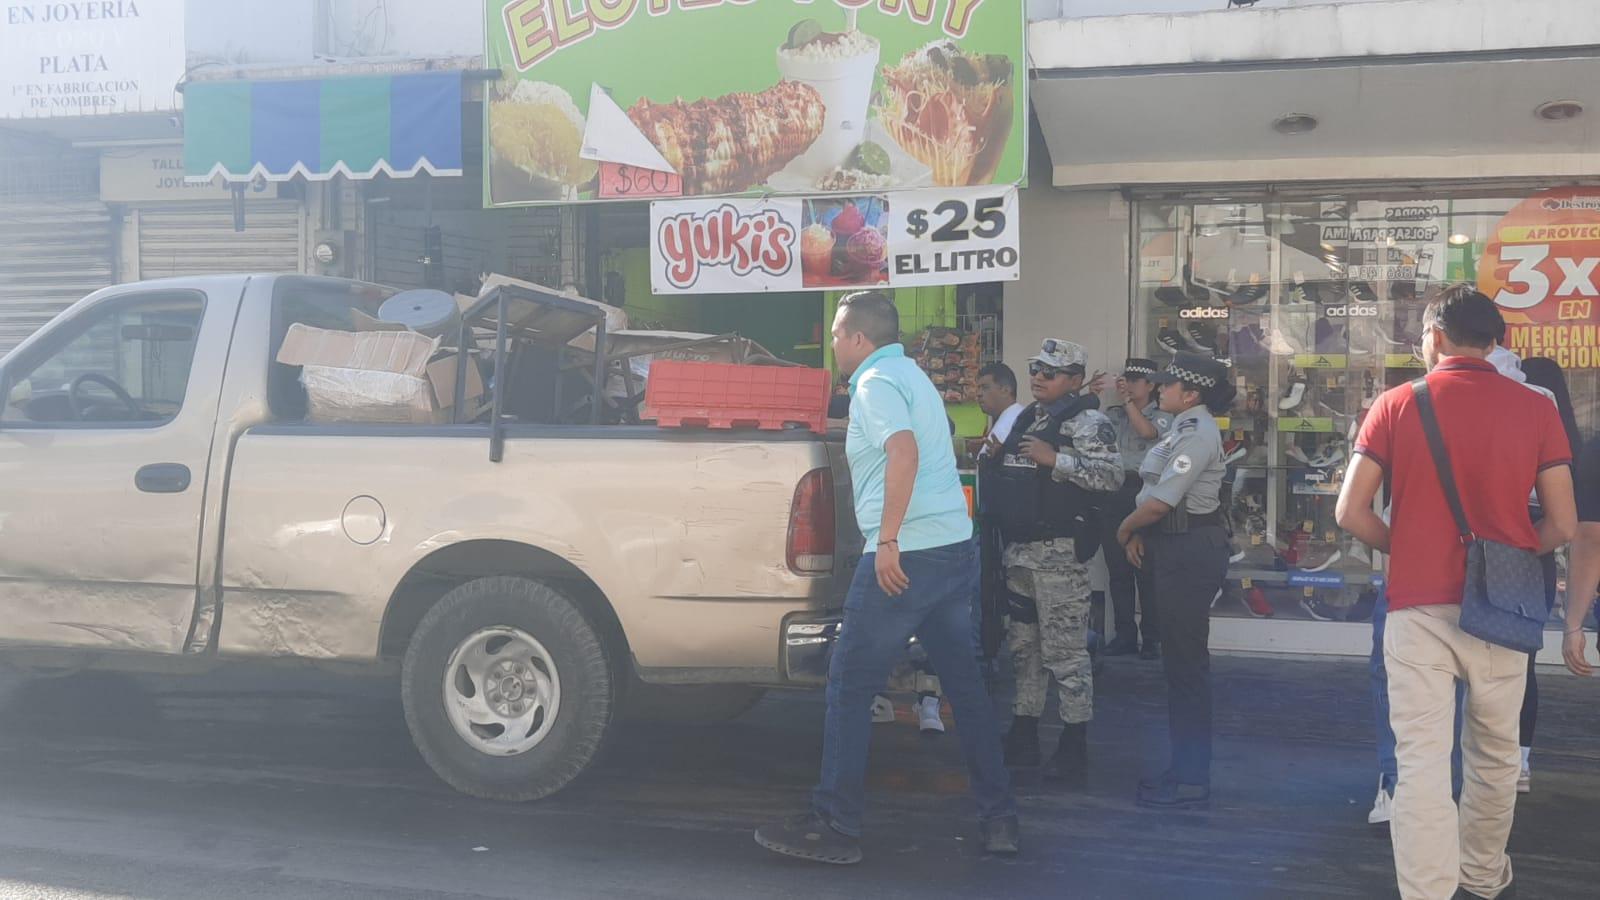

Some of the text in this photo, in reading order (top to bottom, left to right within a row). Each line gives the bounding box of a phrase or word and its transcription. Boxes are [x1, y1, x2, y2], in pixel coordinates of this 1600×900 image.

[8, 6, 35, 25] EN
[40, 54, 109, 74] PLATA
[26, 83, 43, 96] EN
[30, 95, 117, 109] DE NOMBRES
[152, 159, 184, 170] TALL
[905, 196, 1006, 243] $25
[1525, 226, 1600, 240] APROVEC
[895, 246, 1019, 275] EL LITRO
[1179, 306, 1229, 319] adidas
[1326, 304, 1378, 317] addas
[1559, 301, 1591, 319] EN
[1510, 324, 1600, 348] MERCAN
